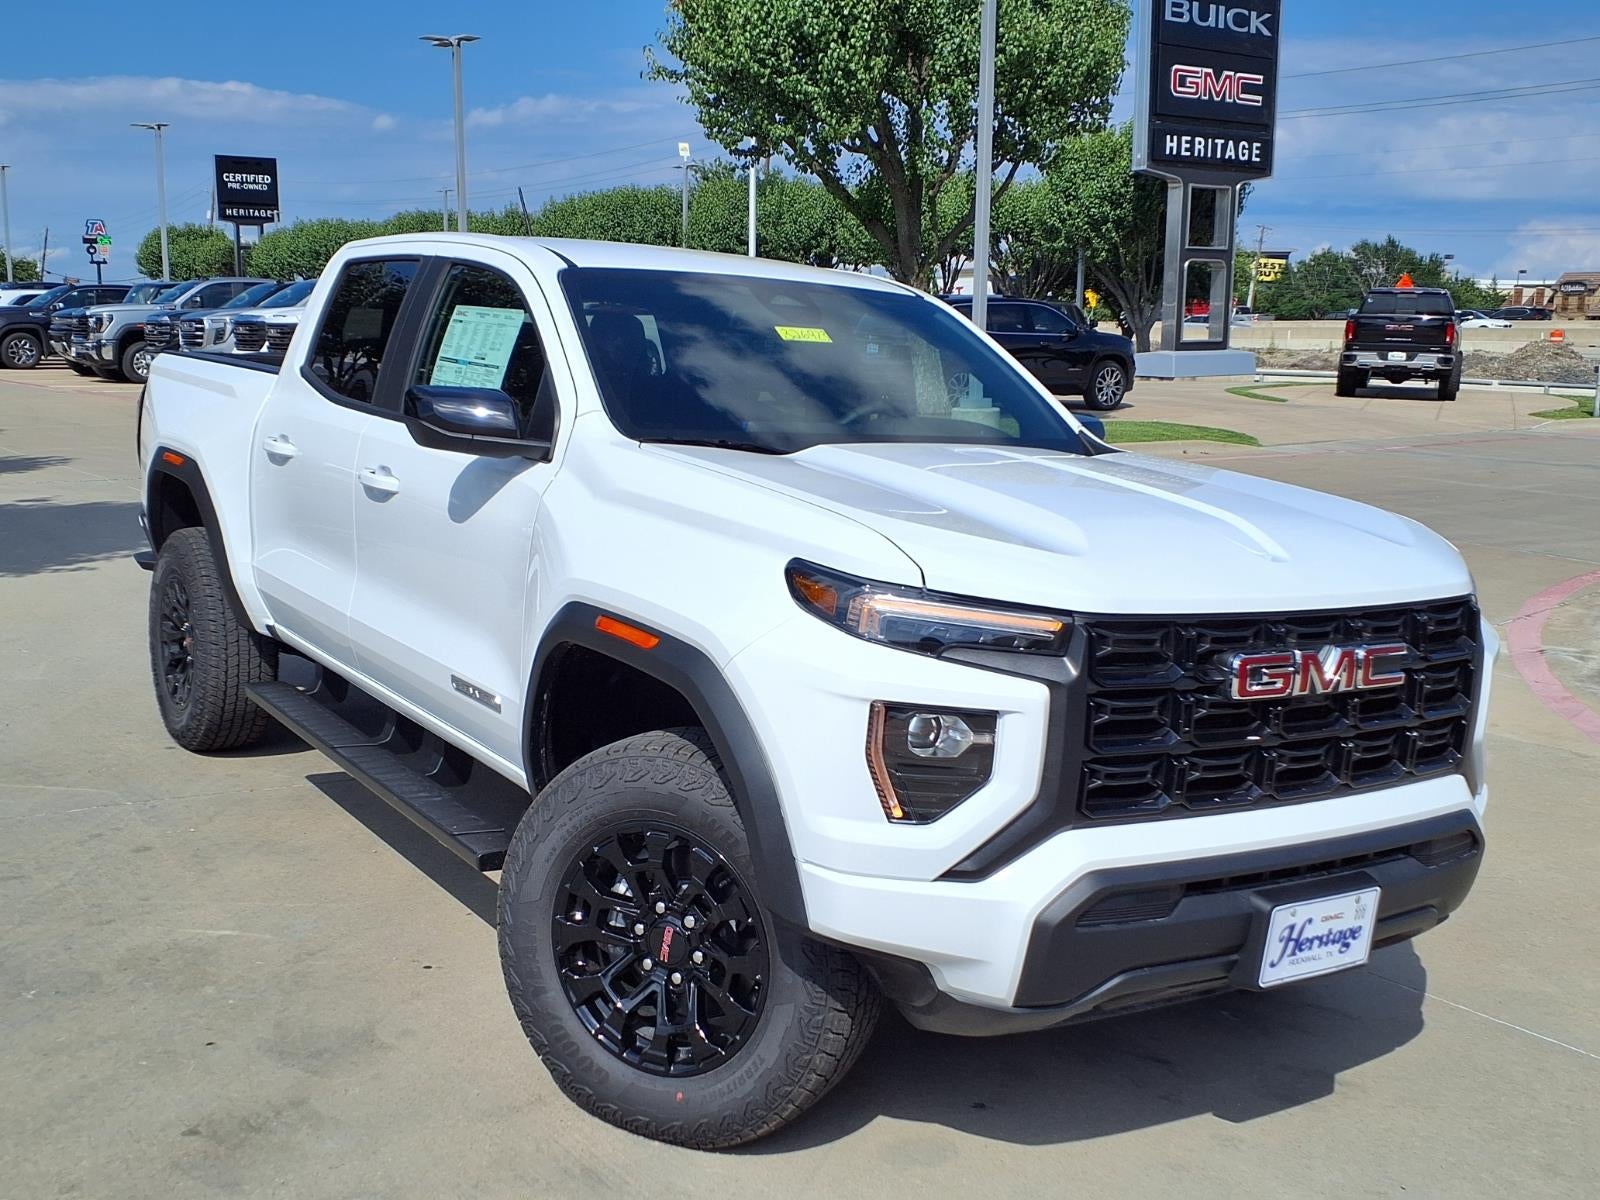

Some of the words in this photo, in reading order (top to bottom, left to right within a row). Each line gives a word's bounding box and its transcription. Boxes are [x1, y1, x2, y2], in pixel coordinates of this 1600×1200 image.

[1164, 0, 1272, 36] BUICK
[1171, 64, 1263, 106] GMC
[1165, 135, 1261, 161] HERITAGE
[223, 173, 271, 183] CERTIFIED
[227, 182, 268, 190] PRE-OWNED
[88, 220, 105, 235] TA
[226, 208, 273, 217] HERITAGE
[1232, 643, 1407, 699] GMC
[660, 926, 674, 963] GMC
[1269, 917, 1363, 968] Heritage
